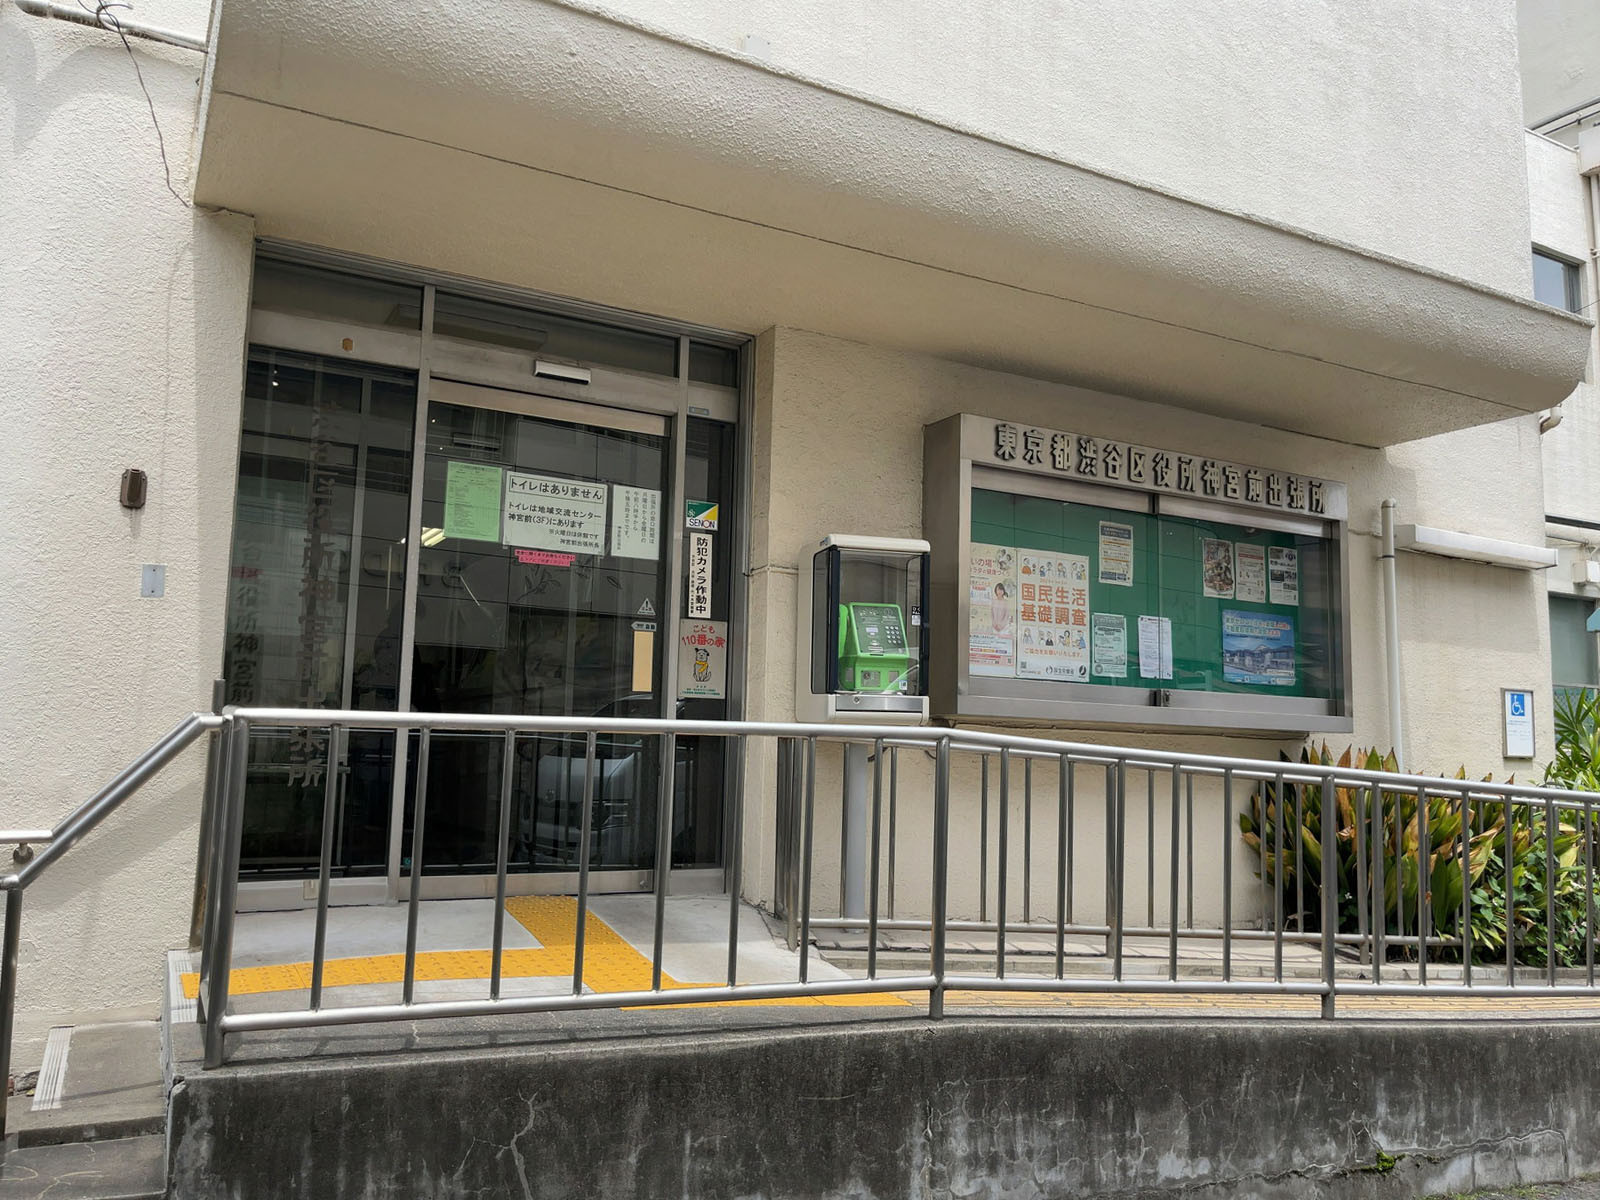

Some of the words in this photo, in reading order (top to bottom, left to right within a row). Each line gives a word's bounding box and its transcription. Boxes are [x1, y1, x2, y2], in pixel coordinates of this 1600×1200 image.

[994, 423, 1327, 515] 東京都渋谷区役所神宮前出張所
[510, 477, 602, 500] トイレはありません
[507, 502, 602, 519] トイレは地域交流センター
[689, 518, 716, 529] SENON
[695, 537, 708, 614] 防犯カメラ作動中
[1021, 582, 1086, 607] 国民生活
[1021, 603, 1087, 627] 基礎調査
[693, 624, 716, 634] こども
